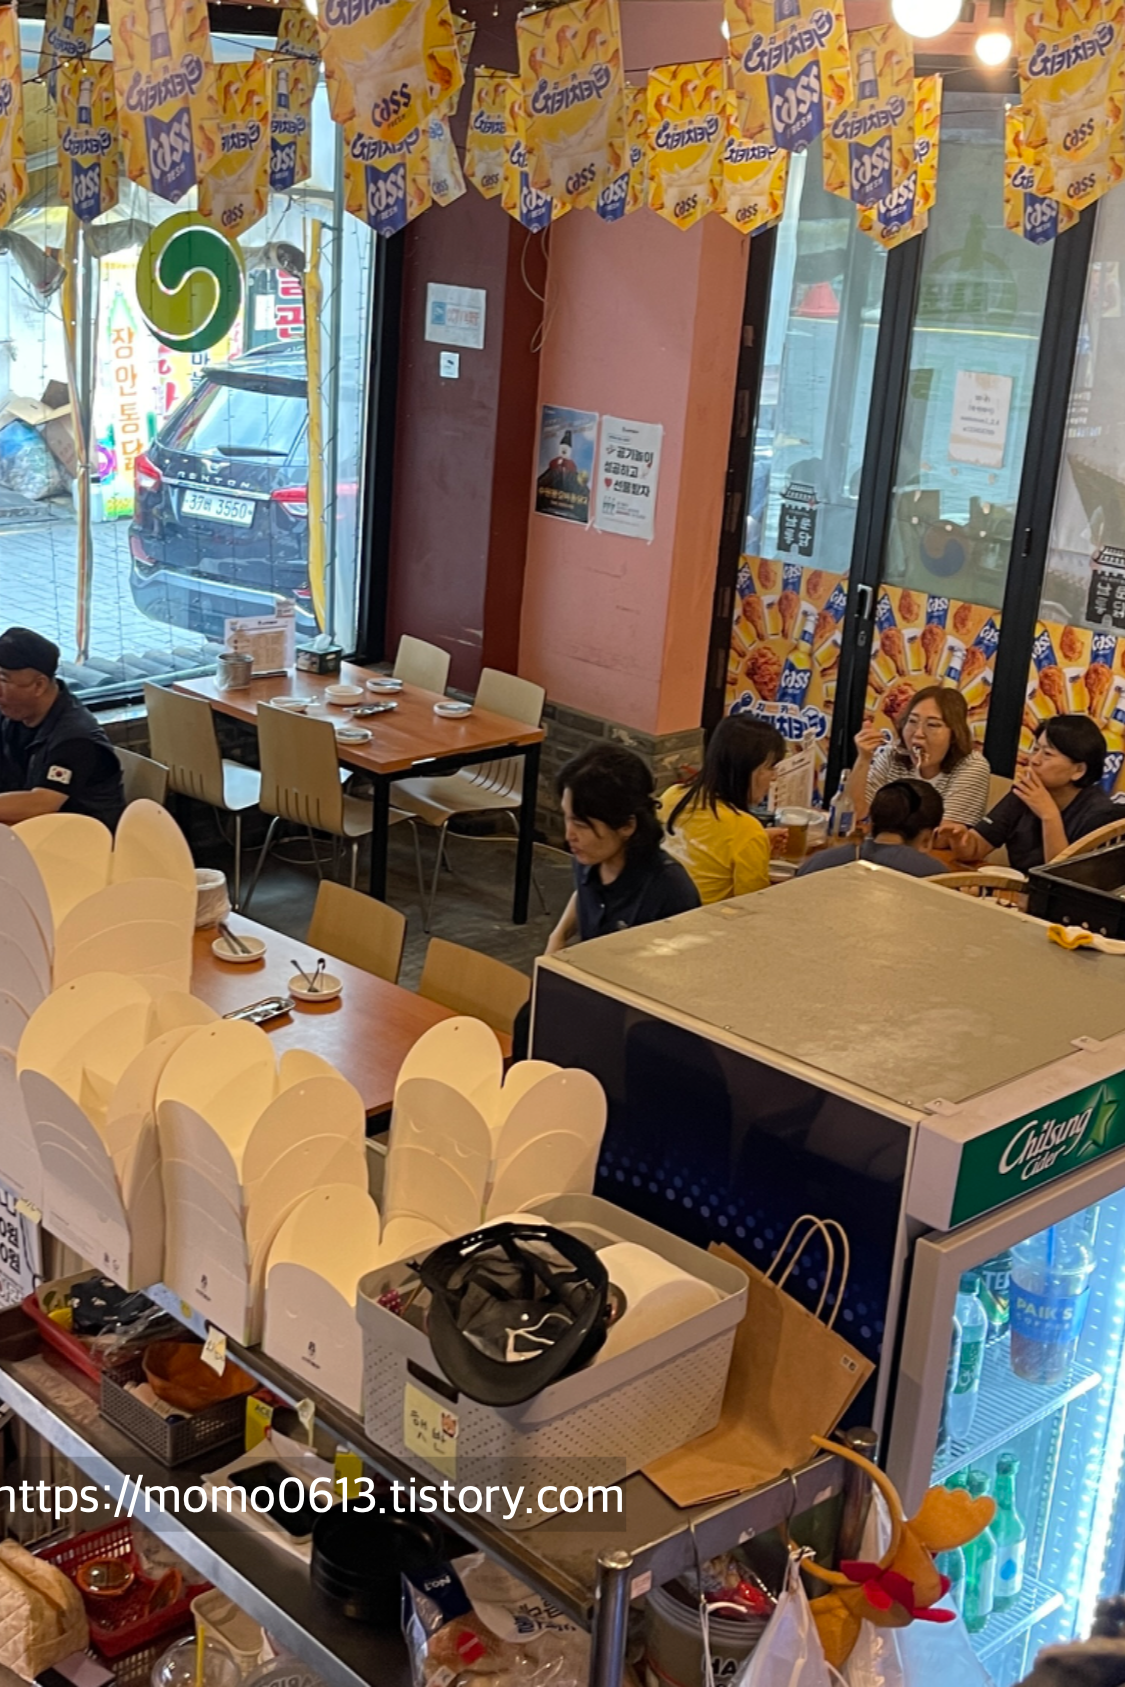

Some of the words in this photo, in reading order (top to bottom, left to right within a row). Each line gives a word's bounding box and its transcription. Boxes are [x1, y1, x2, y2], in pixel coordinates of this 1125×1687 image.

[787, 111, 813, 138] FRESH
[215, 495, 247, 518] 3550
[998, 1108, 1093, 1175] Chilsung
[1020, 1147, 1066, 1181] Cider
